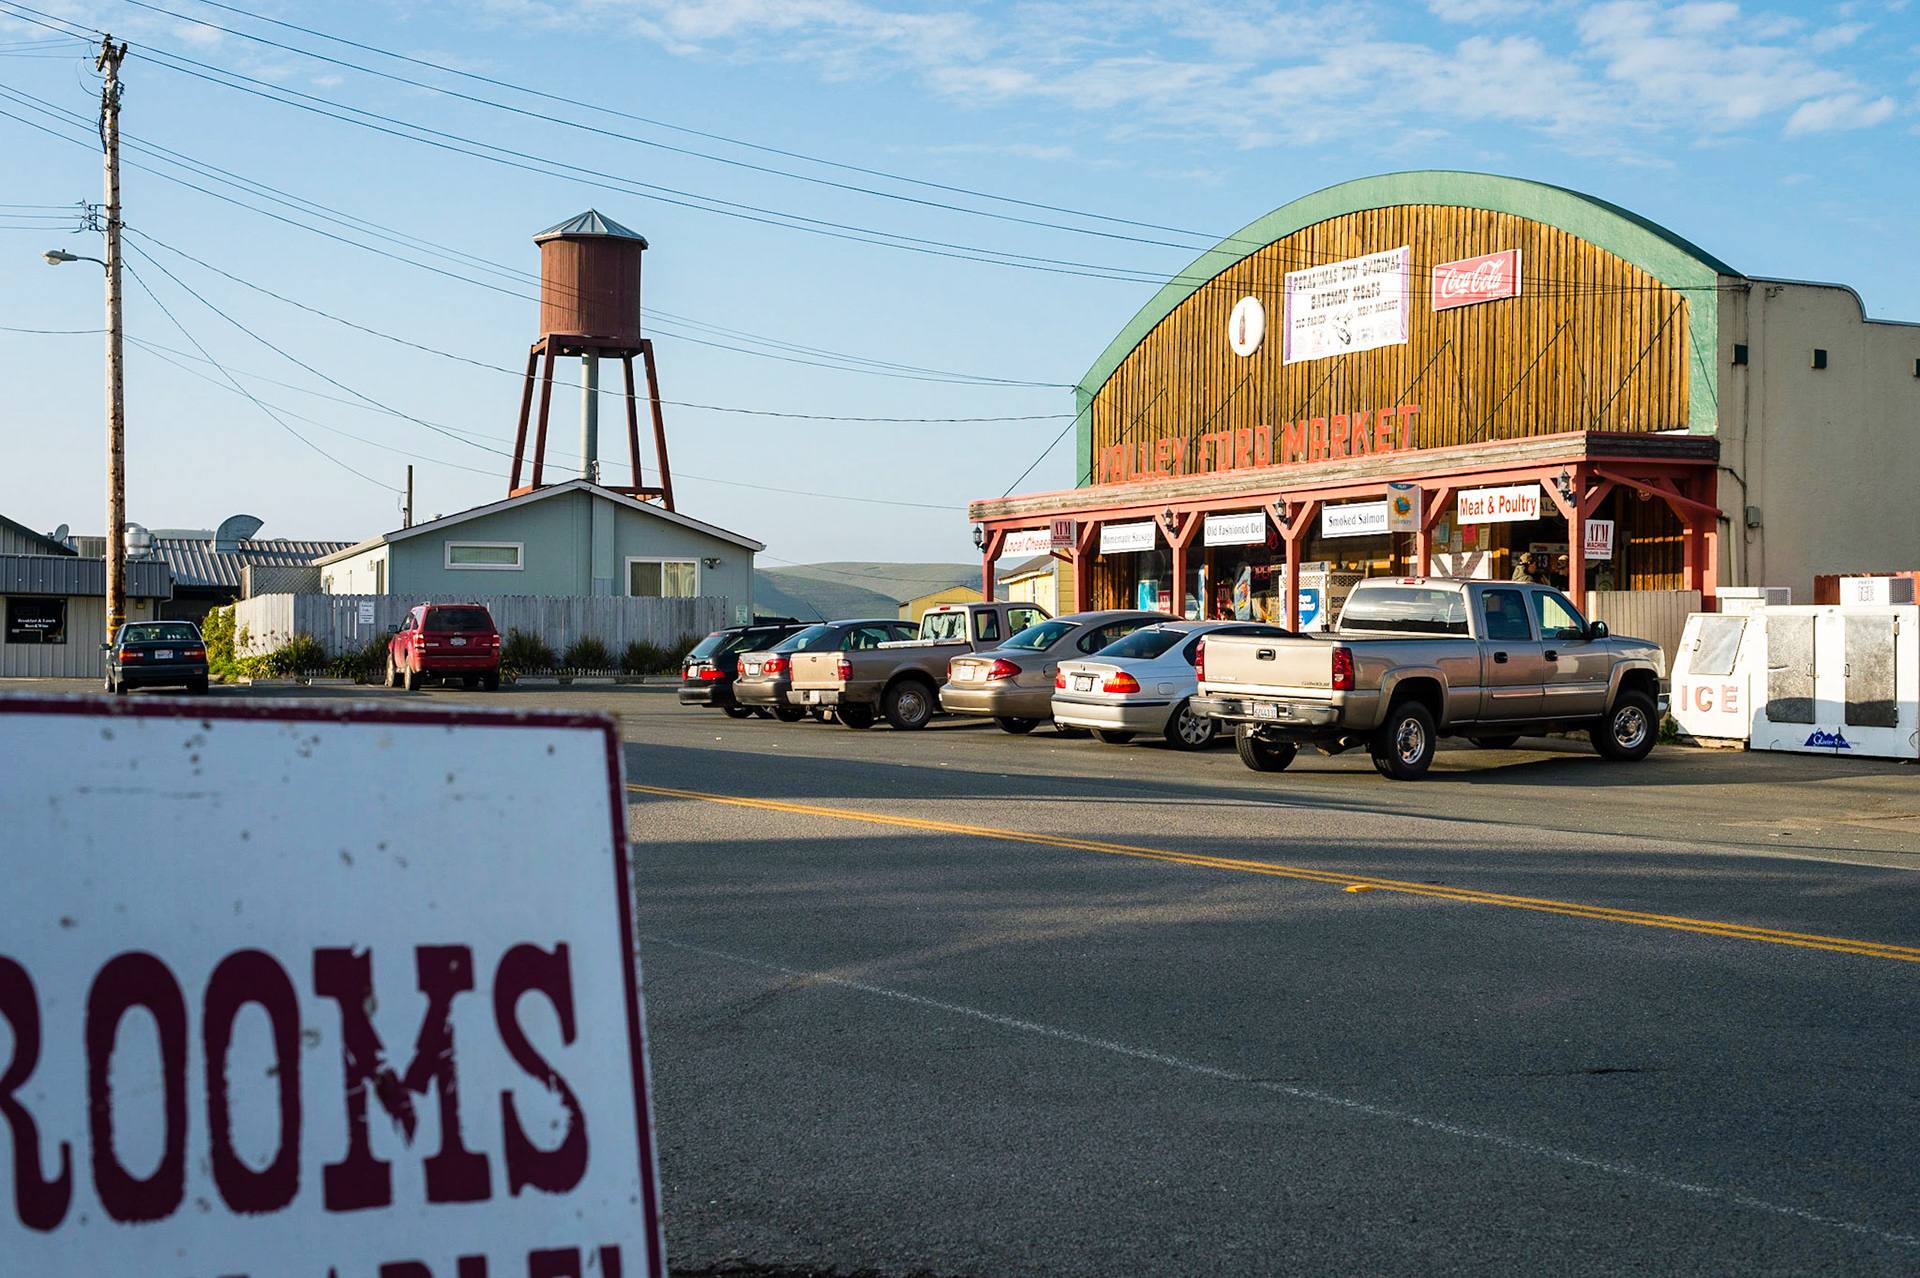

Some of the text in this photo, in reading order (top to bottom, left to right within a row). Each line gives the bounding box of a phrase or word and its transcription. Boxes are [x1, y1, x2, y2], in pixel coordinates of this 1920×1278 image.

[1363, 254, 1400, 276] ORIGINAL
[1441, 259, 1506, 298] Coca-Cola
[1100, 404, 1420, 484] VALLEY FORD MARKET
[1459, 493, 1537, 517] Meat & Poultry
[1055, 521, 1071, 535] ATM
[1206, 522, 1264, 536] Old Fashioned Deli
[1329, 513, 1385, 527] Smoked Salmon
[1102, 532, 1153, 545] Homemade Sausage
[1588, 523, 1609, 541] ATM
[1004, 537, 1051, 552] Local Cheese
[1681, 684, 1738, 713] ICE
